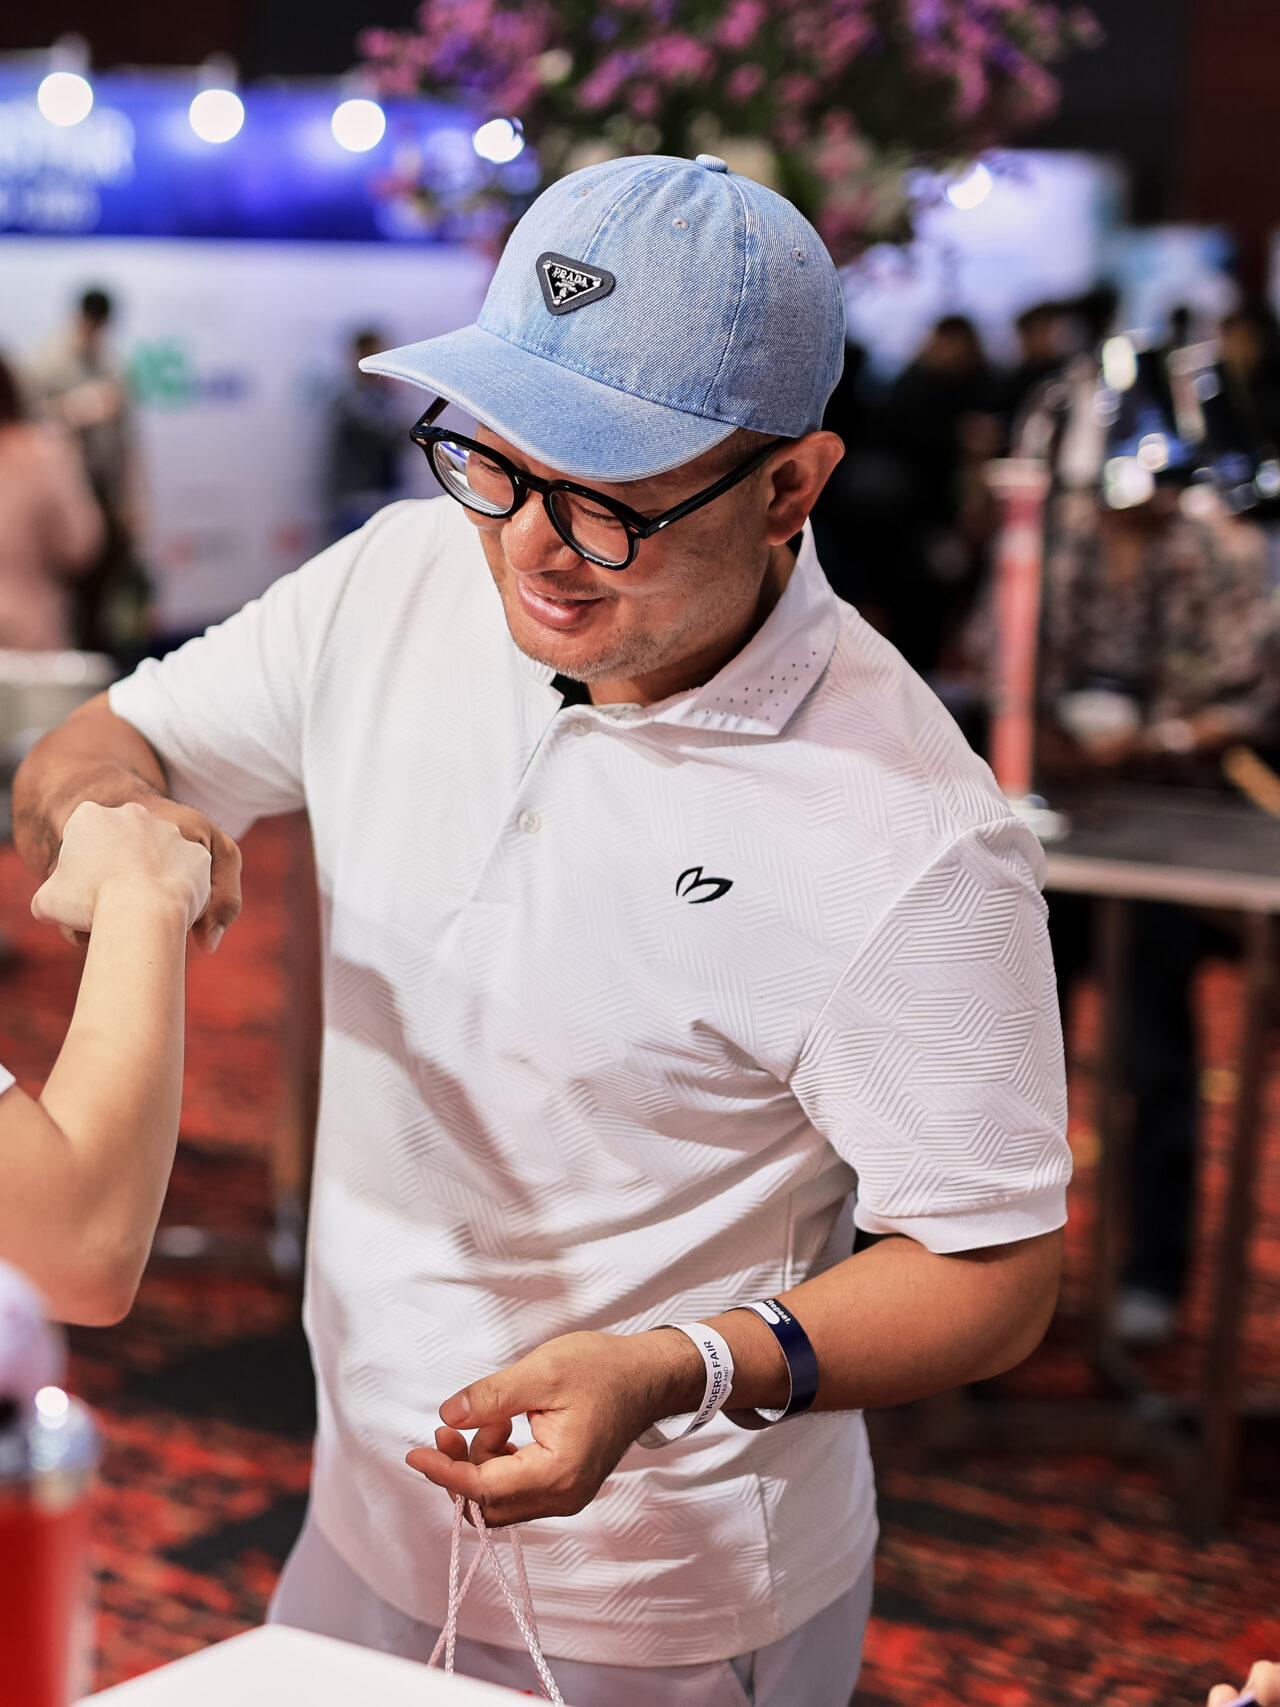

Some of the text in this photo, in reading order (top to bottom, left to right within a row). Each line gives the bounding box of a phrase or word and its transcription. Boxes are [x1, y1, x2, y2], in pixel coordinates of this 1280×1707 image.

[551, 266, 588, 288] PRADA
[697, 1340, 722, 1422] TRADERS FAIR
